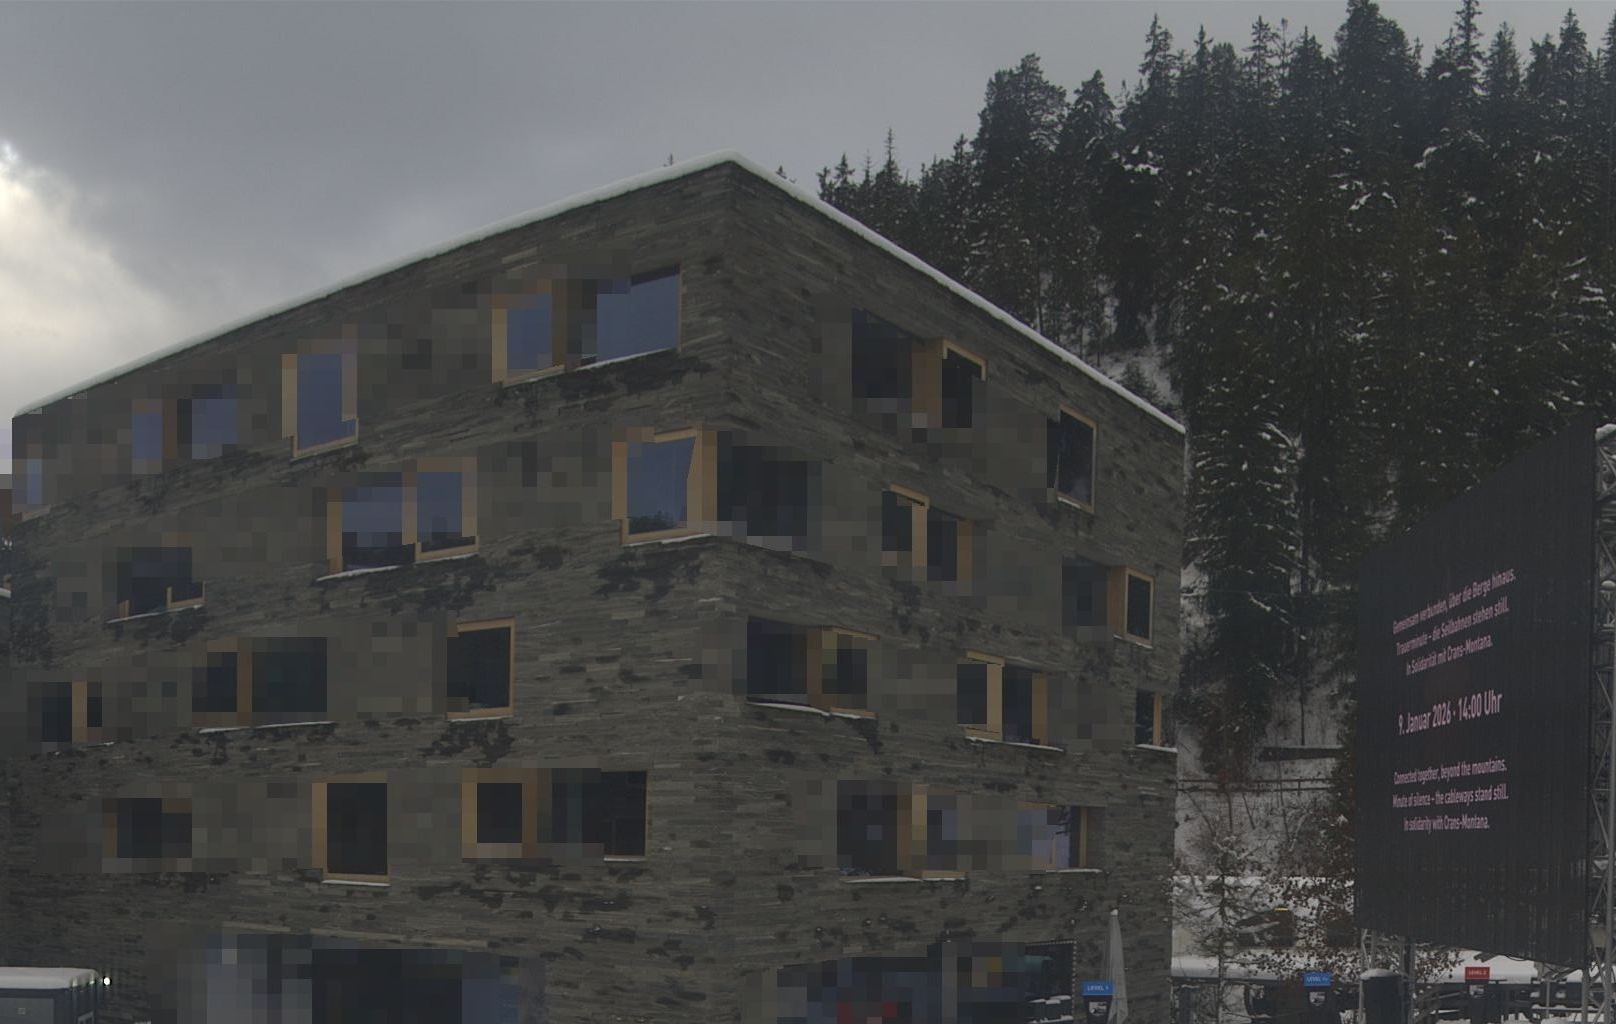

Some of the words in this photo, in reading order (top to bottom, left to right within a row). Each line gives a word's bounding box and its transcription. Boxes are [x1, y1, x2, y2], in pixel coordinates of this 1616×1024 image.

[1398, 714, 1404, 735] 9.
[1406, 712, 1431, 733] Januar
[1433, 701, 1451, 728] 2026
[1458, 692, 1482, 720] 14:00
[1484, 690, 1502, 715] Uhr
